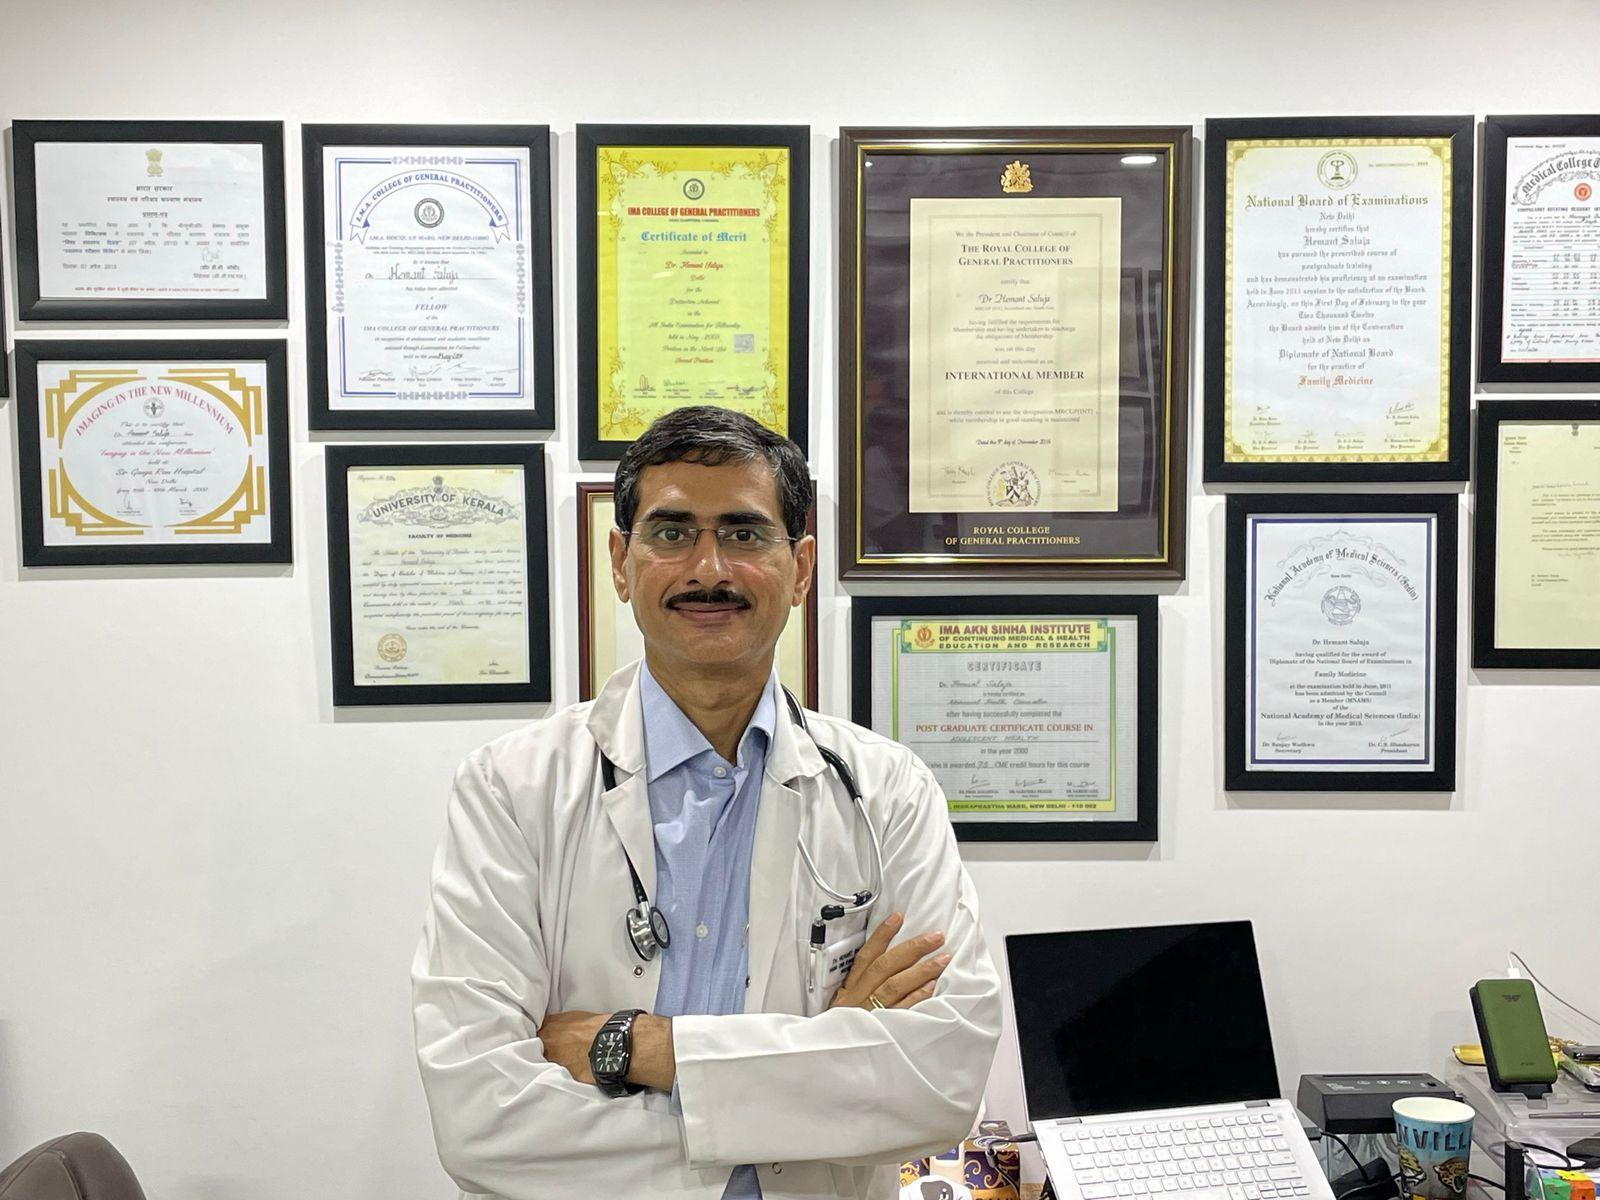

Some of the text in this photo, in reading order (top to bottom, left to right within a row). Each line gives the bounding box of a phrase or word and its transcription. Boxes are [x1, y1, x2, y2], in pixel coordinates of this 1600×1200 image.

[1522, 156, 1592, 196] Medical College
[356, 173, 504, 222] I.M.A. COLLEGE OF GENERAL PRACTITIONERS
[1245, 193, 1429, 211] National Board of Examinations
[628, 207, 760, 216] IMA COLLEGE OF GENERAL PRACTITIONERS
[640, 231, 748, 242] Certificate of Merit
[961, 244, 1071, 253] THE ROYAL COLLEGE OF
[958, 256, 1073, 266] GENERAL PRACTITIONERS
[945, 370, 1085, 380] INTERNATIONAL MEMBER
[1298, 375, 1374, 388] Family Medicine
[75, 396, 115, 437] IMAGING
[115, 392, 127, 405] IN
[128, 387, 148, 400] THE
[150, 384, 174, 396] NEW
[176, 388, 235, 435] MILLENNIUM
[372, 493, 504, 518] UNIVERSITY OF KERALA
[973, 526, 1050, 534] ROYAL COLLEGE
[945, 536, 1081, 545] OF GENERAL PRACTITIONERS
[1264, 548, 1419, 608] National Academy of Medical Sciences (India)
[940, 624, 1091, 634] IMA AKN SINHA INSTITUTE
[967, 661, 1042, 672] CERTIFICATE
[1260, 712, 1421, 720] National Academy of Medical Sciences (India)
[916, 724, 1094, 732] POST GRADUATE CERTIFICATE COURSE IN
[1398, 1123, 1473, 1151] NVILL
